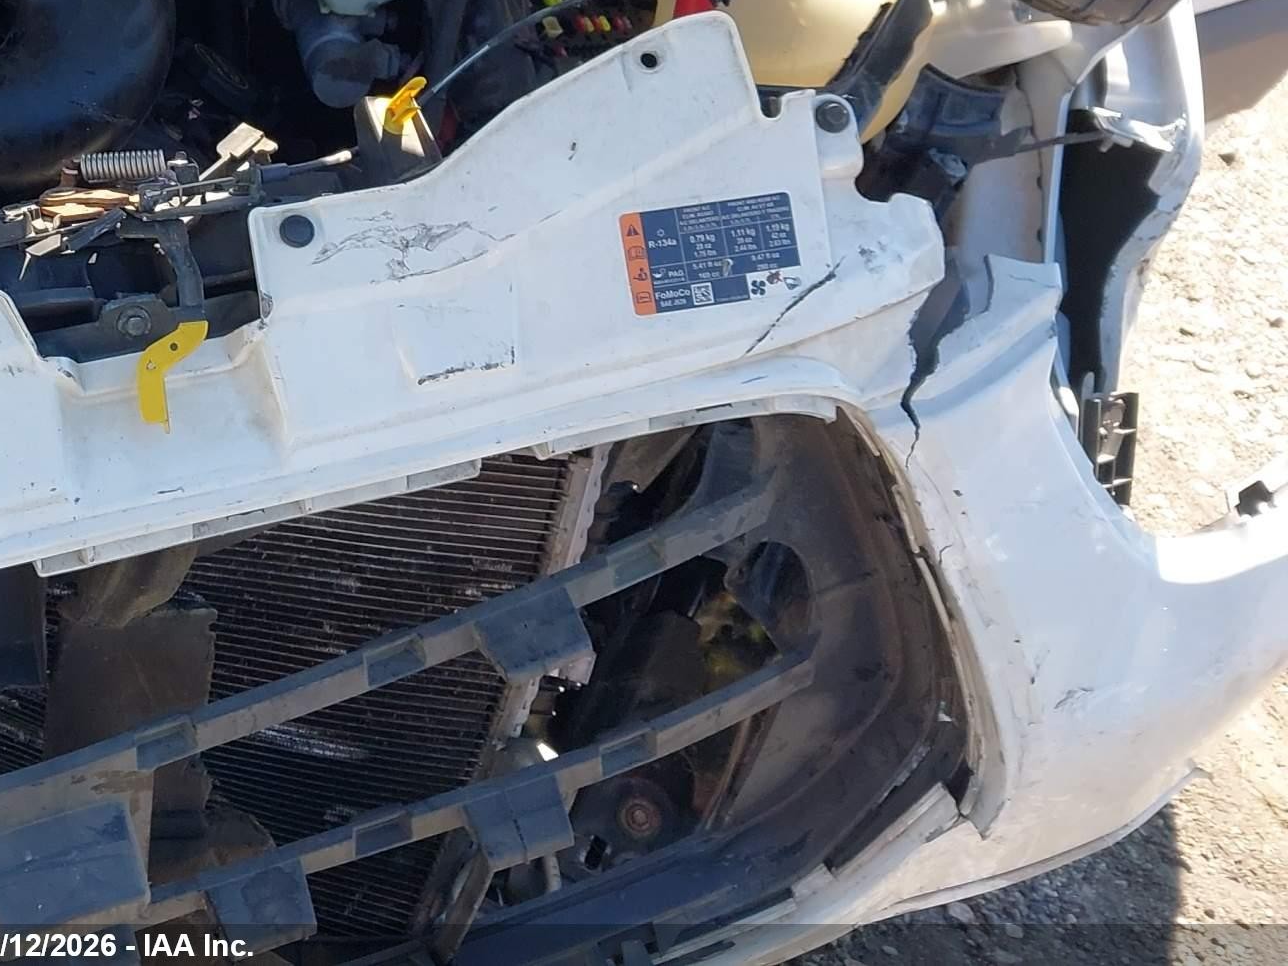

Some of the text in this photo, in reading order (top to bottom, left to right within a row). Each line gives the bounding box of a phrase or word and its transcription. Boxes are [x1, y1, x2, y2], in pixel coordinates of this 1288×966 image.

[731, 227, 756, 237] 1.11 kg
[780, 223, 790, 232] kg
[689, 233, 716, 243] 0.79 kg
[648, 238, 677, 249] R-134a
[655, 288, 691, 300] FoMoCo
